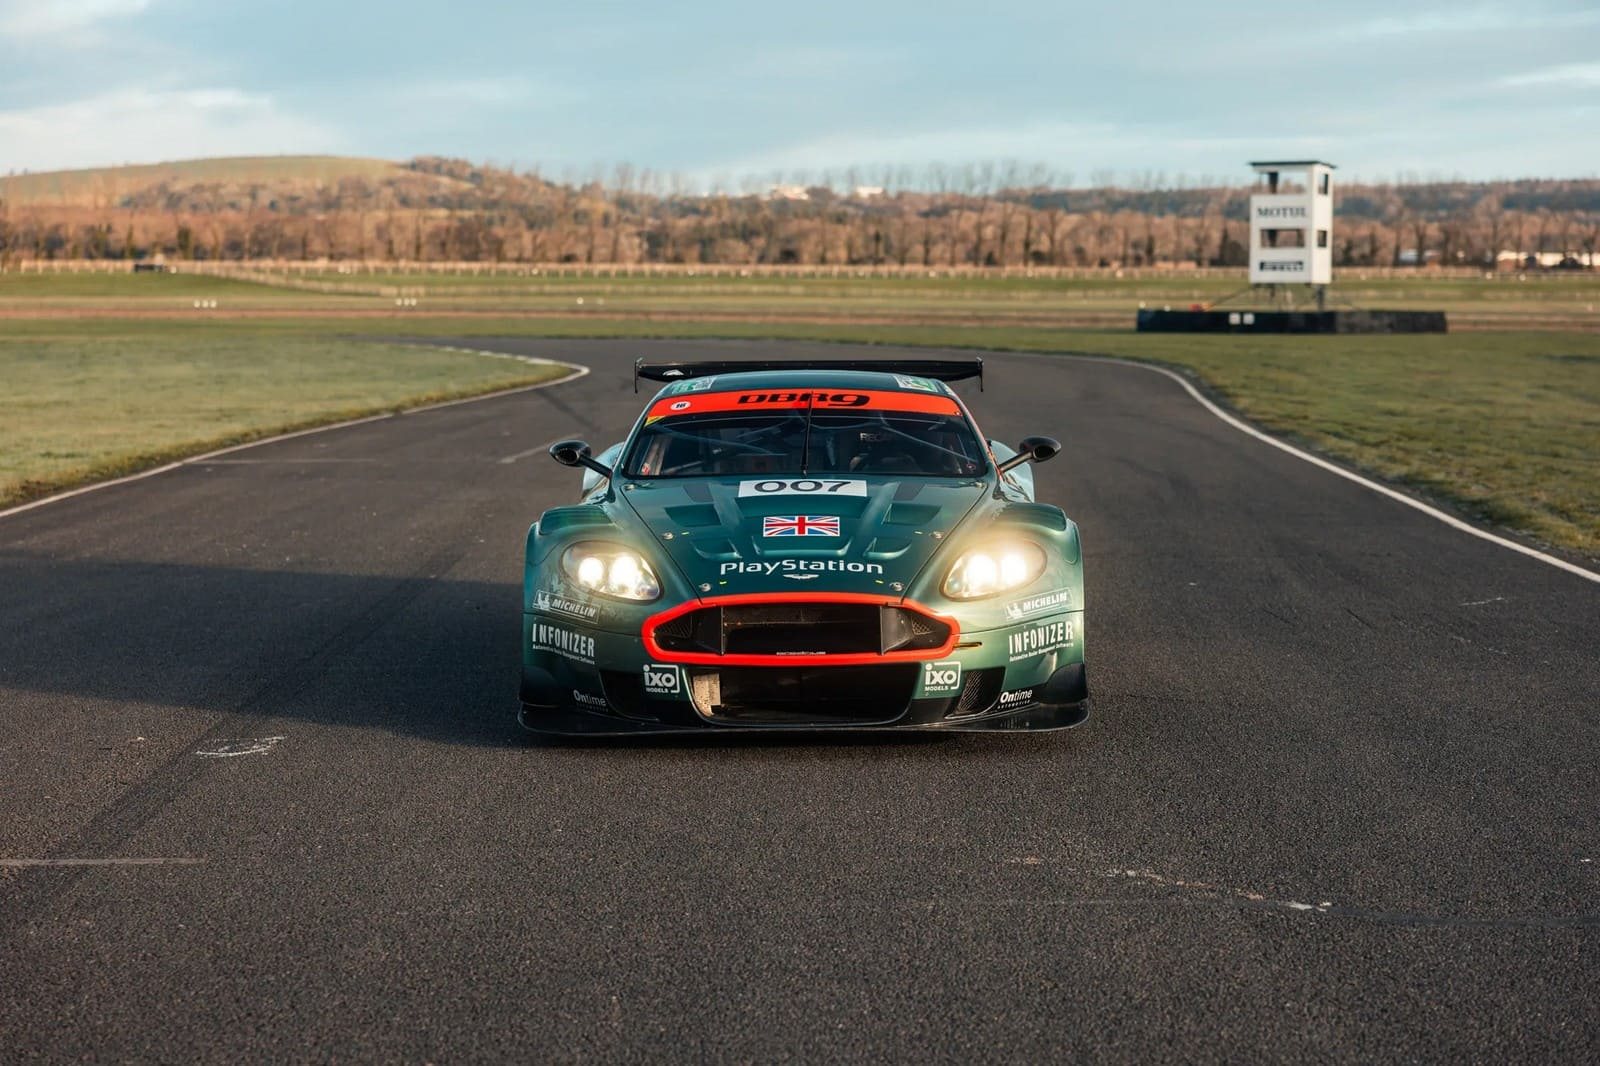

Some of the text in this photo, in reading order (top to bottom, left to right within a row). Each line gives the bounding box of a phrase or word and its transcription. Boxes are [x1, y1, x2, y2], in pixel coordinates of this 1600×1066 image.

[1257, 207, 1306, 218] MOTUL
[738, 394, 870, 407] DBR9
[754, 481, 852, 493] 007
[721, 560, 883, 575] PlayStation
[551, 598, 597, 617] MICHELIN
[1023, 592, 1067, 611] MICHELIN
[533, 624, 594, 657] INFONIZER
[1009, 621, 1074, 655] INFONIZER
[573, 688, 607, 704] Ontime
[999, 689, 1033, 704] Ontime
